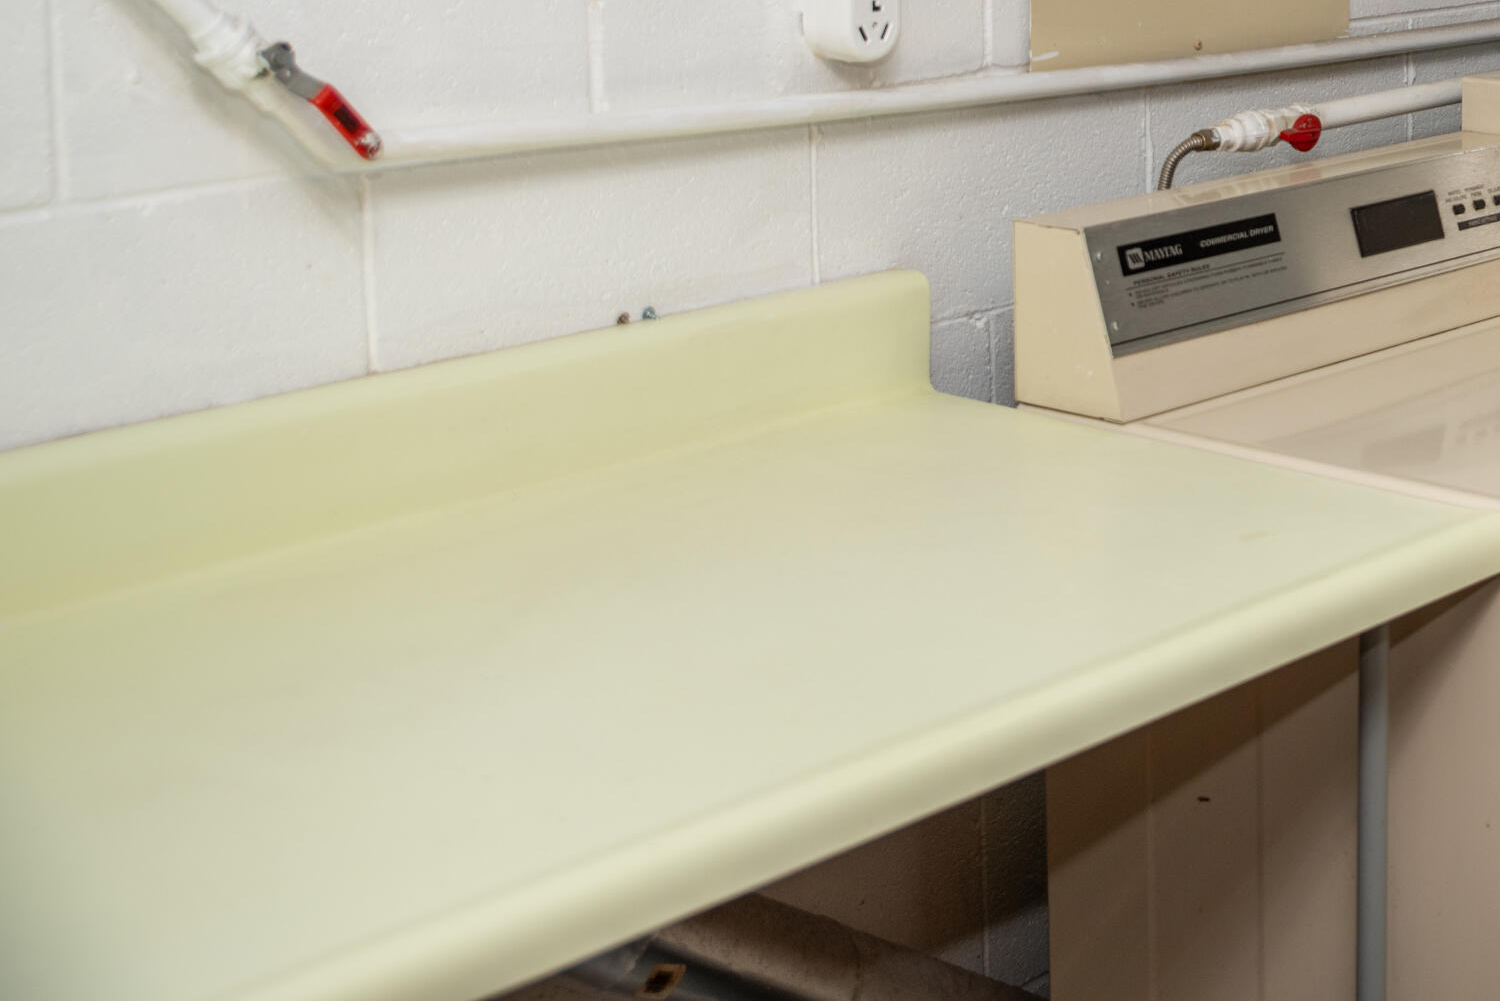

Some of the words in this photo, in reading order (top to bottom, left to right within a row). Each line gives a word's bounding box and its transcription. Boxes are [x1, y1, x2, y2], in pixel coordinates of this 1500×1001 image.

[1144, 244, 1183, 262] MAYTAG
[1200, 232, 1248, 248] COMMERCIAL
[1249, 224, 1274, 237] DRYER
